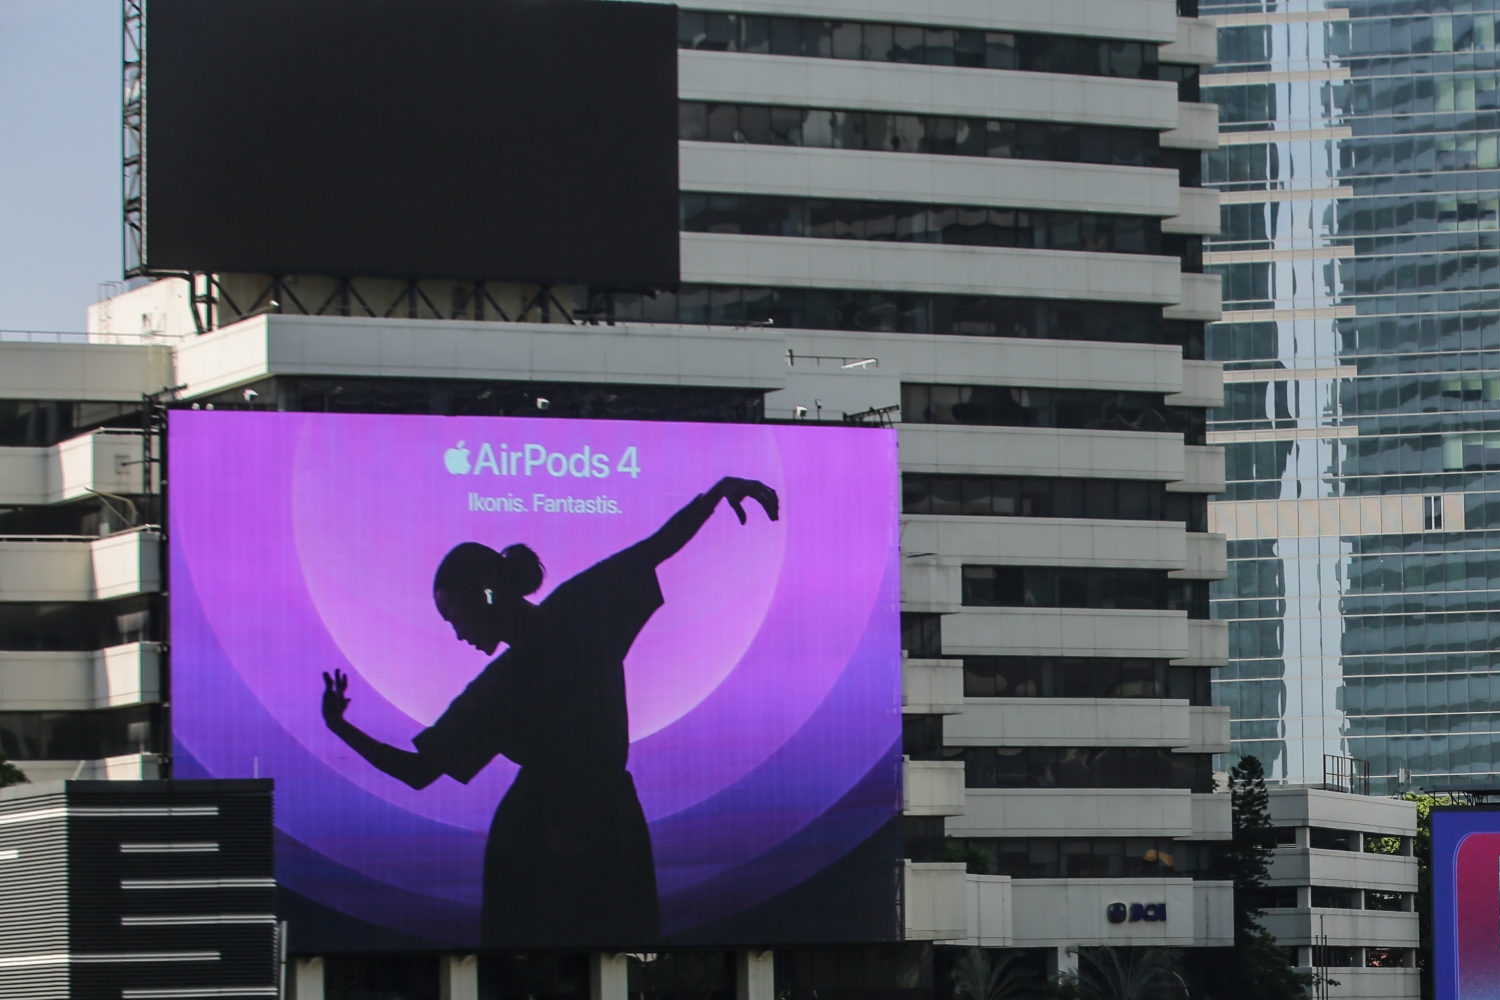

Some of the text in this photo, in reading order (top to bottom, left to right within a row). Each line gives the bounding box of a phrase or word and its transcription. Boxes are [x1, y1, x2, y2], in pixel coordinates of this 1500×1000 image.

[473, 442, 641, 479] AirPods 4
[468, 492, 623, 515] Ikonis. Fantastis.
